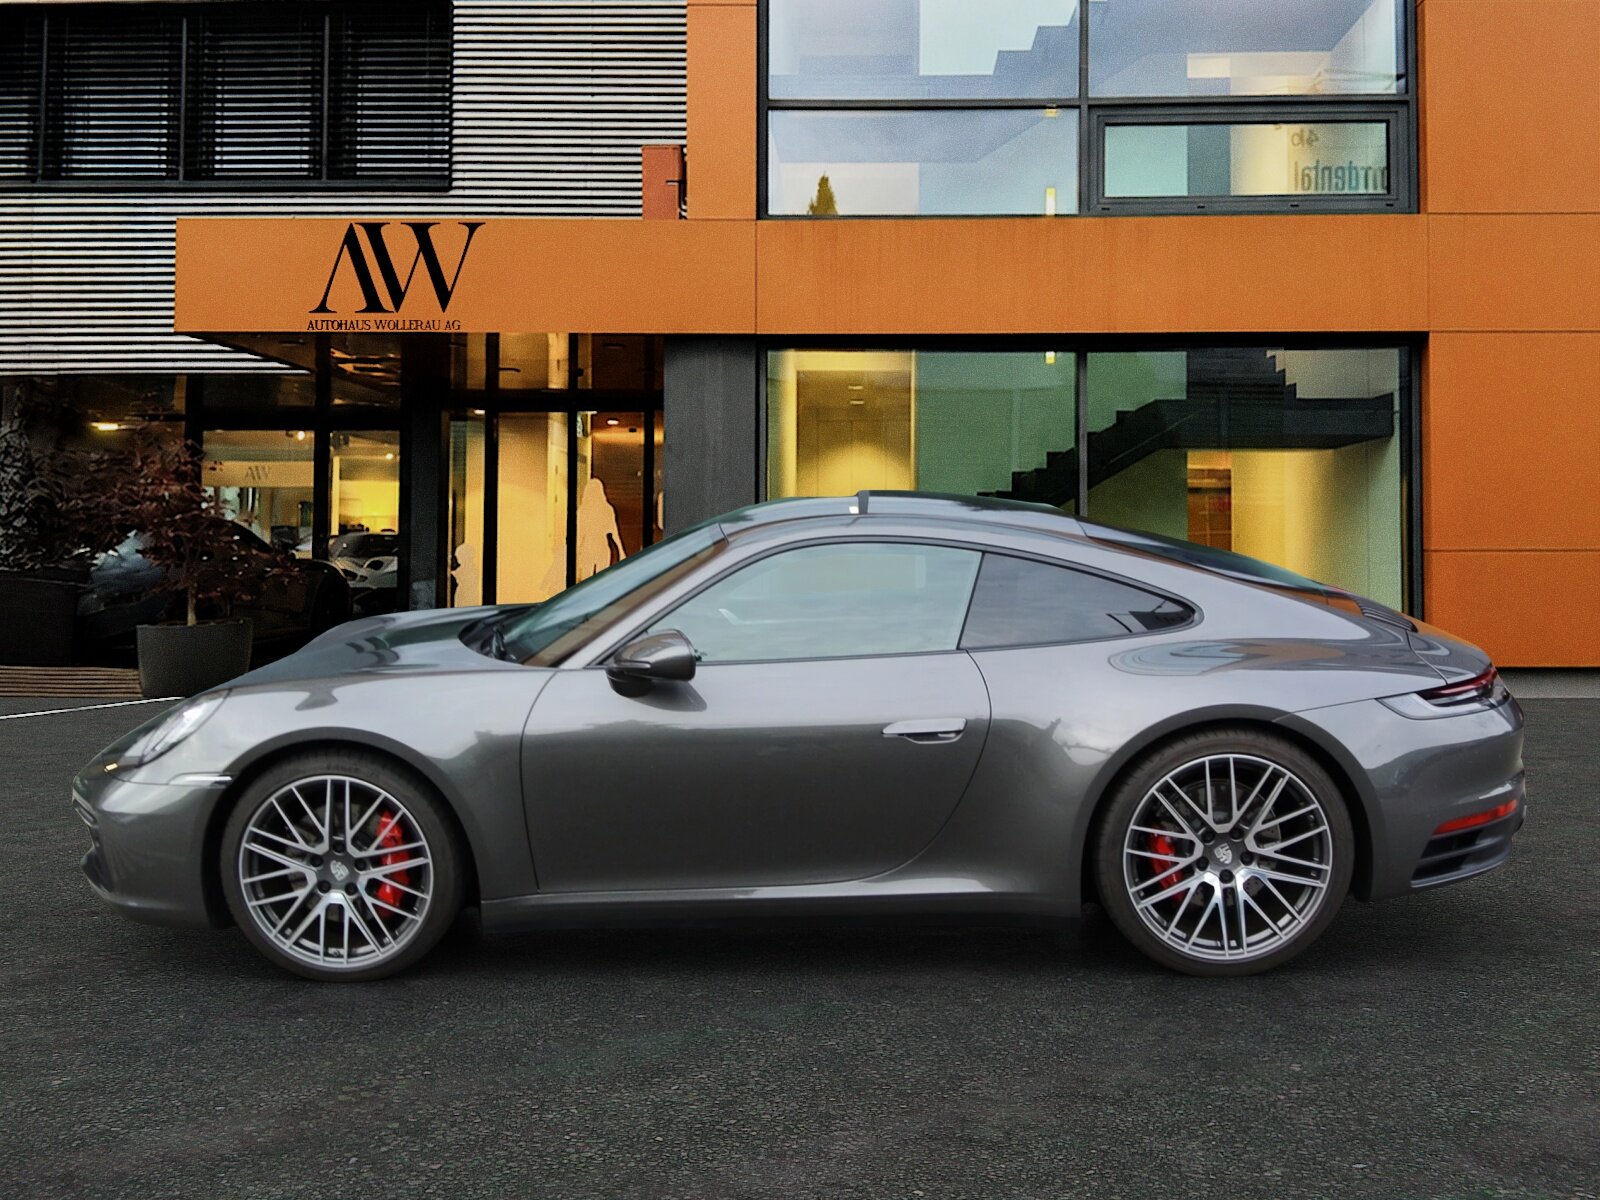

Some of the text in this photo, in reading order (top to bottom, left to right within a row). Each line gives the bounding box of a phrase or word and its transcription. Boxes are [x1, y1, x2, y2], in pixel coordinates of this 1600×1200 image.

[308, 222, 486, 313] AW
[307, 320, 461, 331] AUTOHAUS WOLLERAU AG
